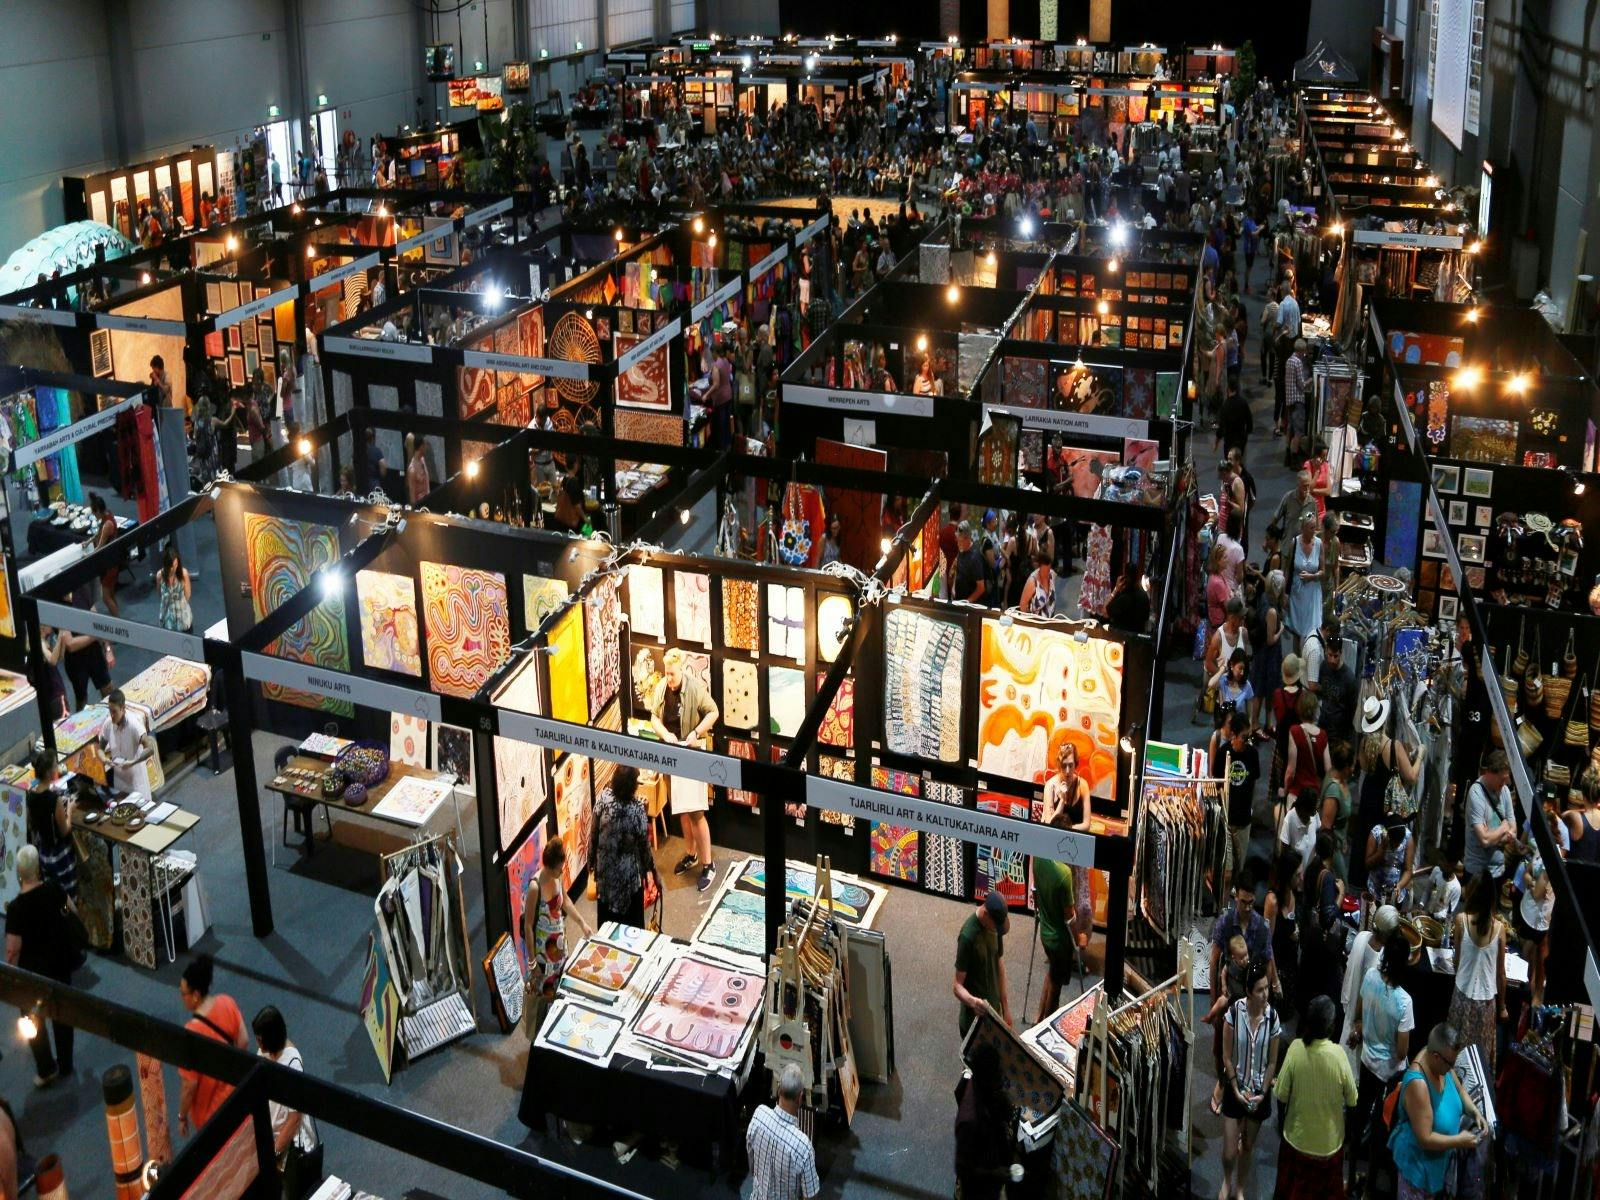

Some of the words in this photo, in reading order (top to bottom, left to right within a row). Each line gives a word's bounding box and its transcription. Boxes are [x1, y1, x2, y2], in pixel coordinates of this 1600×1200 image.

[828, 396, 855, 405] MERREPEN
[1024, 415, 1052, 424] LARRAKIA
[1052, 418, 1073, 426] NATION
[1074, 420, 1089, 428] ARTS
[59, 433, 70, 444] ARTS
[75, 421, 97, 436] CULTURAL
[1388, 435, 1396, 444] 31
[93, 622, 114, 635] NINUKU
[114, 627, 130, 638] ARTS
[307, 676, 333, 691] NINUKU
[333, 682, 351, 694] ARTS
[480, 716, 492, 730] 56
[1468, 710, 1481, 722] 33
[535, 728, 573, 745] TJARLIRLI
[574, 736, 590, 748] ART
[591, 739, 597, 750] &
[598, 741, 660, 765] KALTUKATJARA
[661, 756, 678, 768] ART
[849, 797, 894, 816] TJARLIRLI
[896, 807, 915, 820] ART
[917, 811, 924, 822] &
[925, 814, 999, 839] KALTUKATJARA
[1000, 831, 1020, 844] ART
